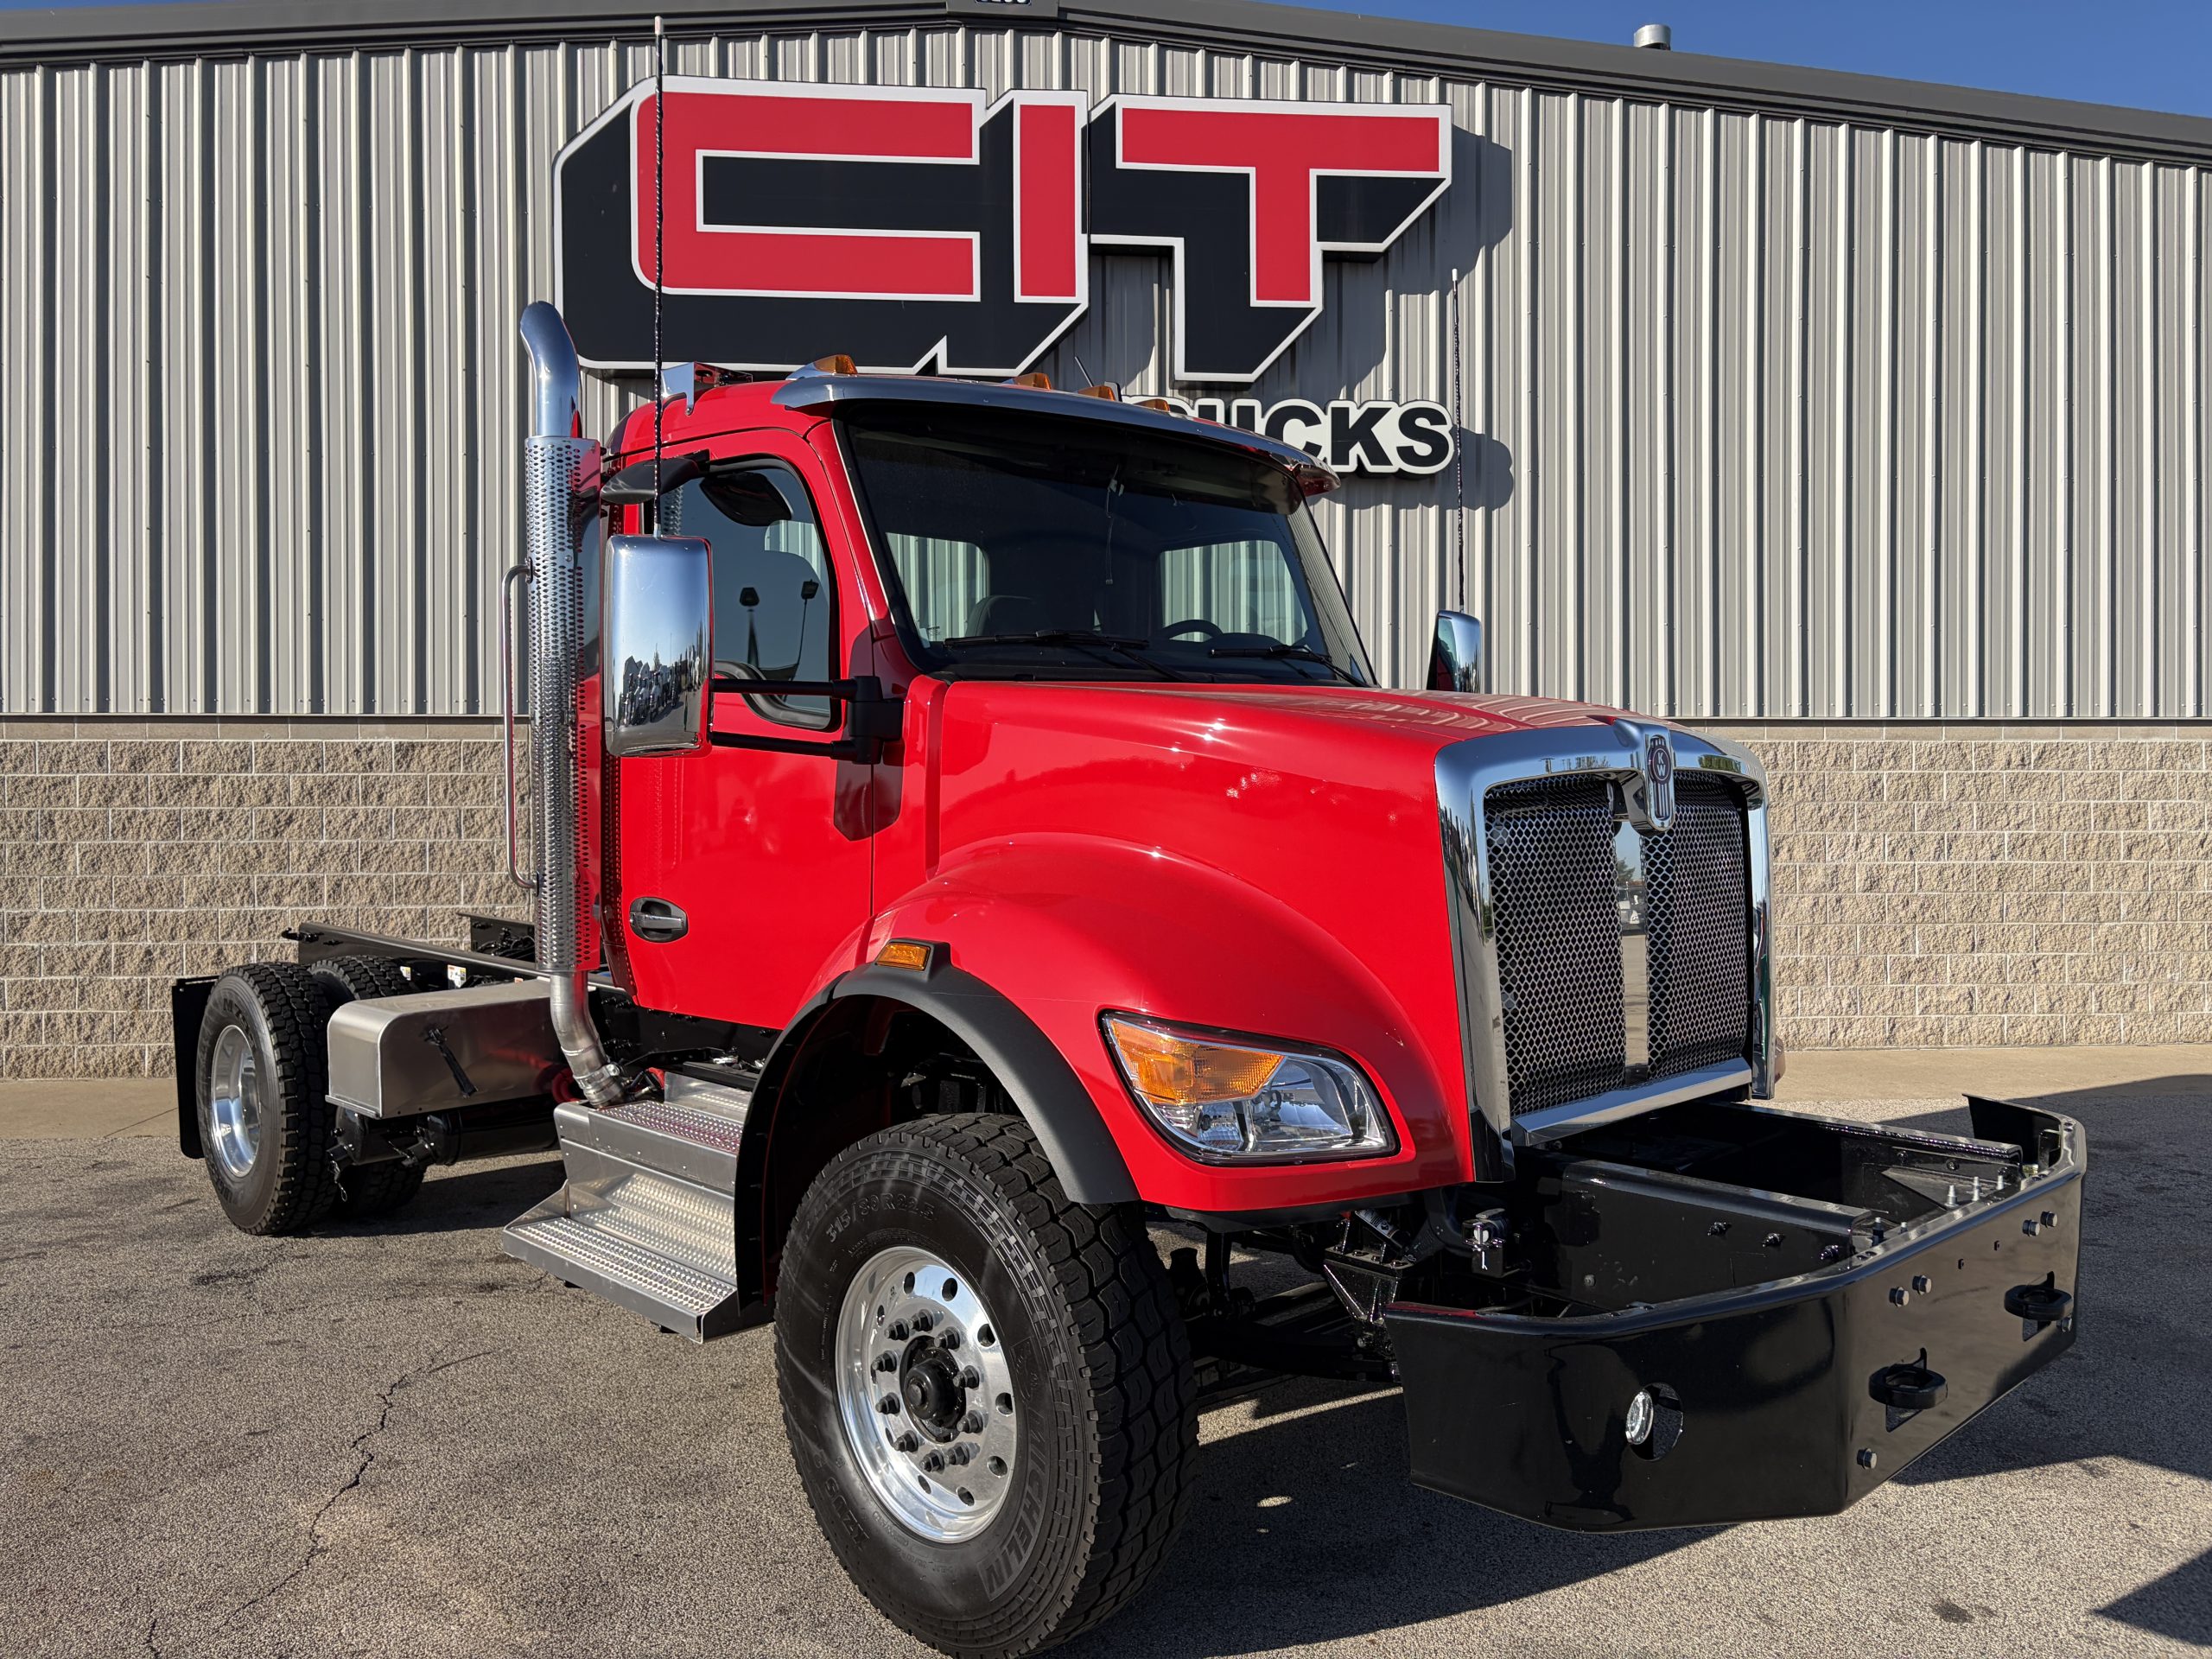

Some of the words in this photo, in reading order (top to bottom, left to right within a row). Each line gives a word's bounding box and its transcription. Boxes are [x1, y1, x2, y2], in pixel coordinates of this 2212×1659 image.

[632, 76, 1452, 308] CIT
[1168, 399, 1453, 473] CKS
[984, 1407, 1048, 1594] MICHELIN
